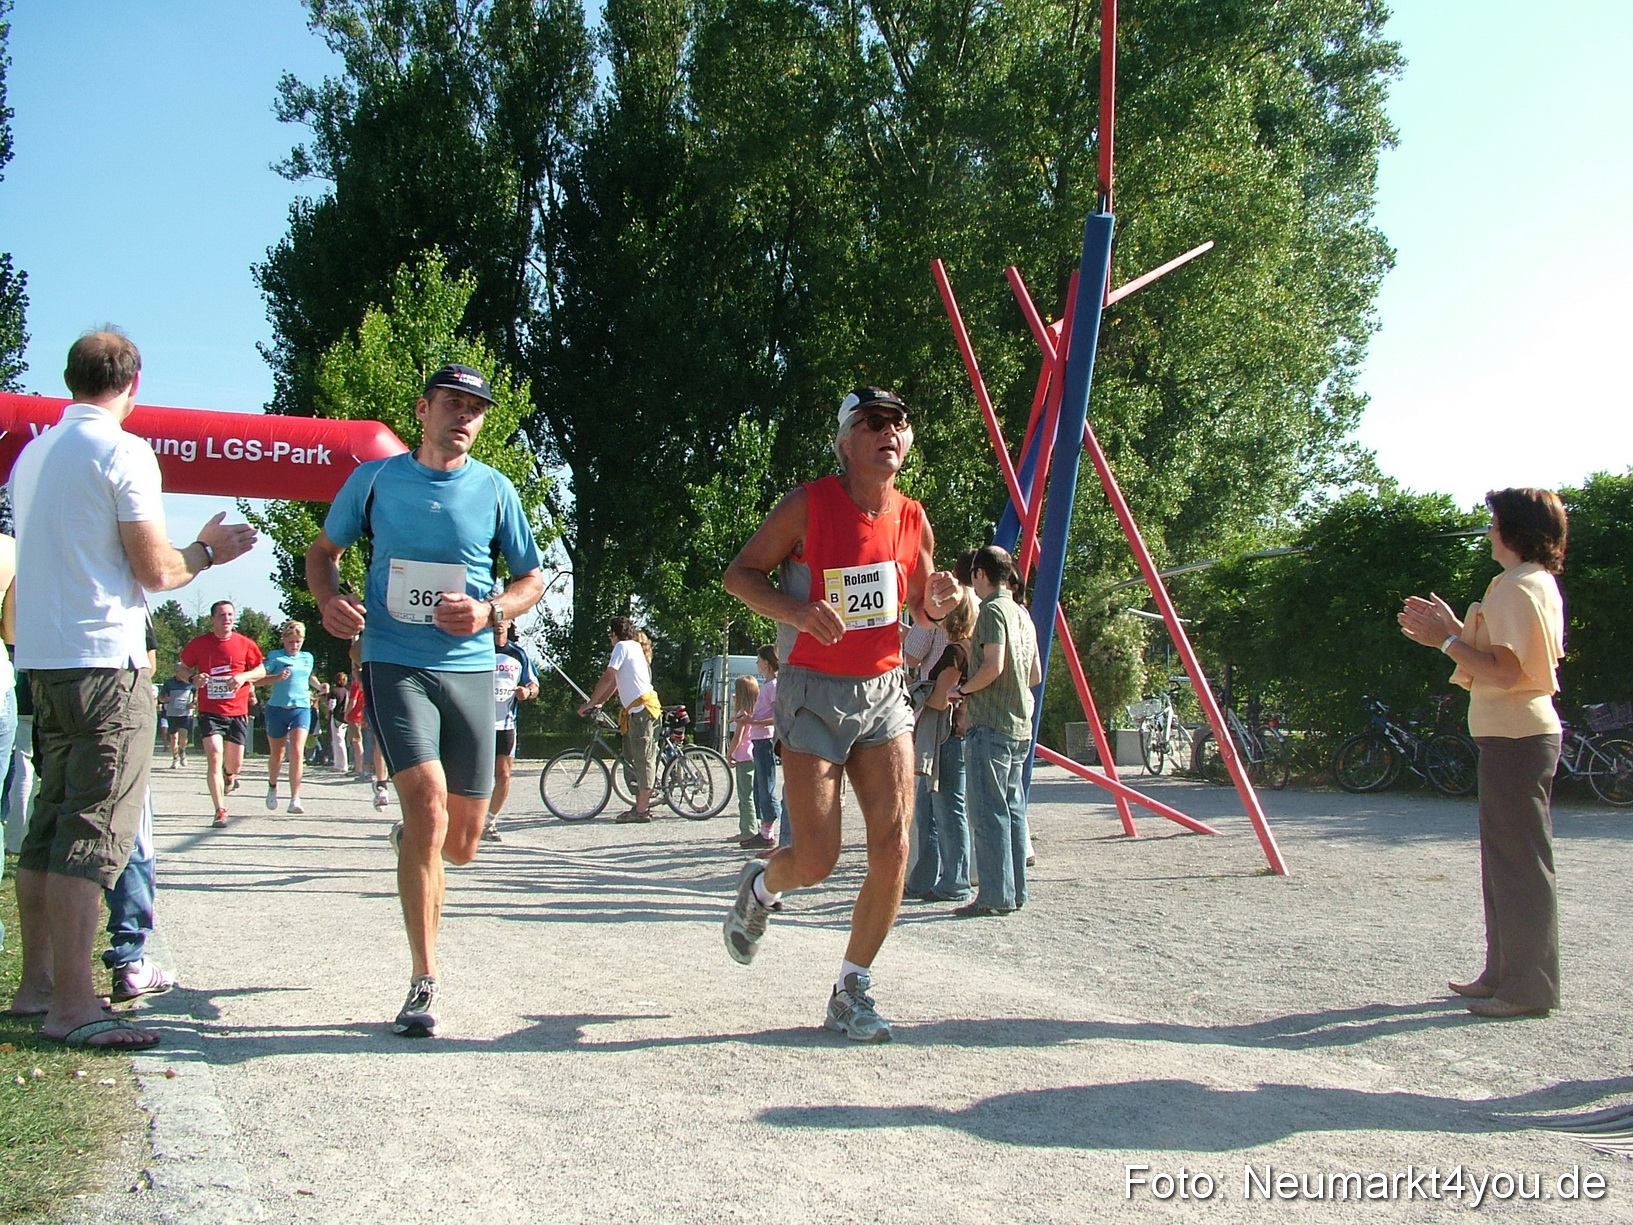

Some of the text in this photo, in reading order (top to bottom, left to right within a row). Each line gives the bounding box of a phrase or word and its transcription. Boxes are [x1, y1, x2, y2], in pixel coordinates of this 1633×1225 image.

[206, 437, 332, 465] LGS-Park
[844, 571, 880, 586] Roland
[830, 593, 839, 603] B
[848, 591, 884, 613] 240
